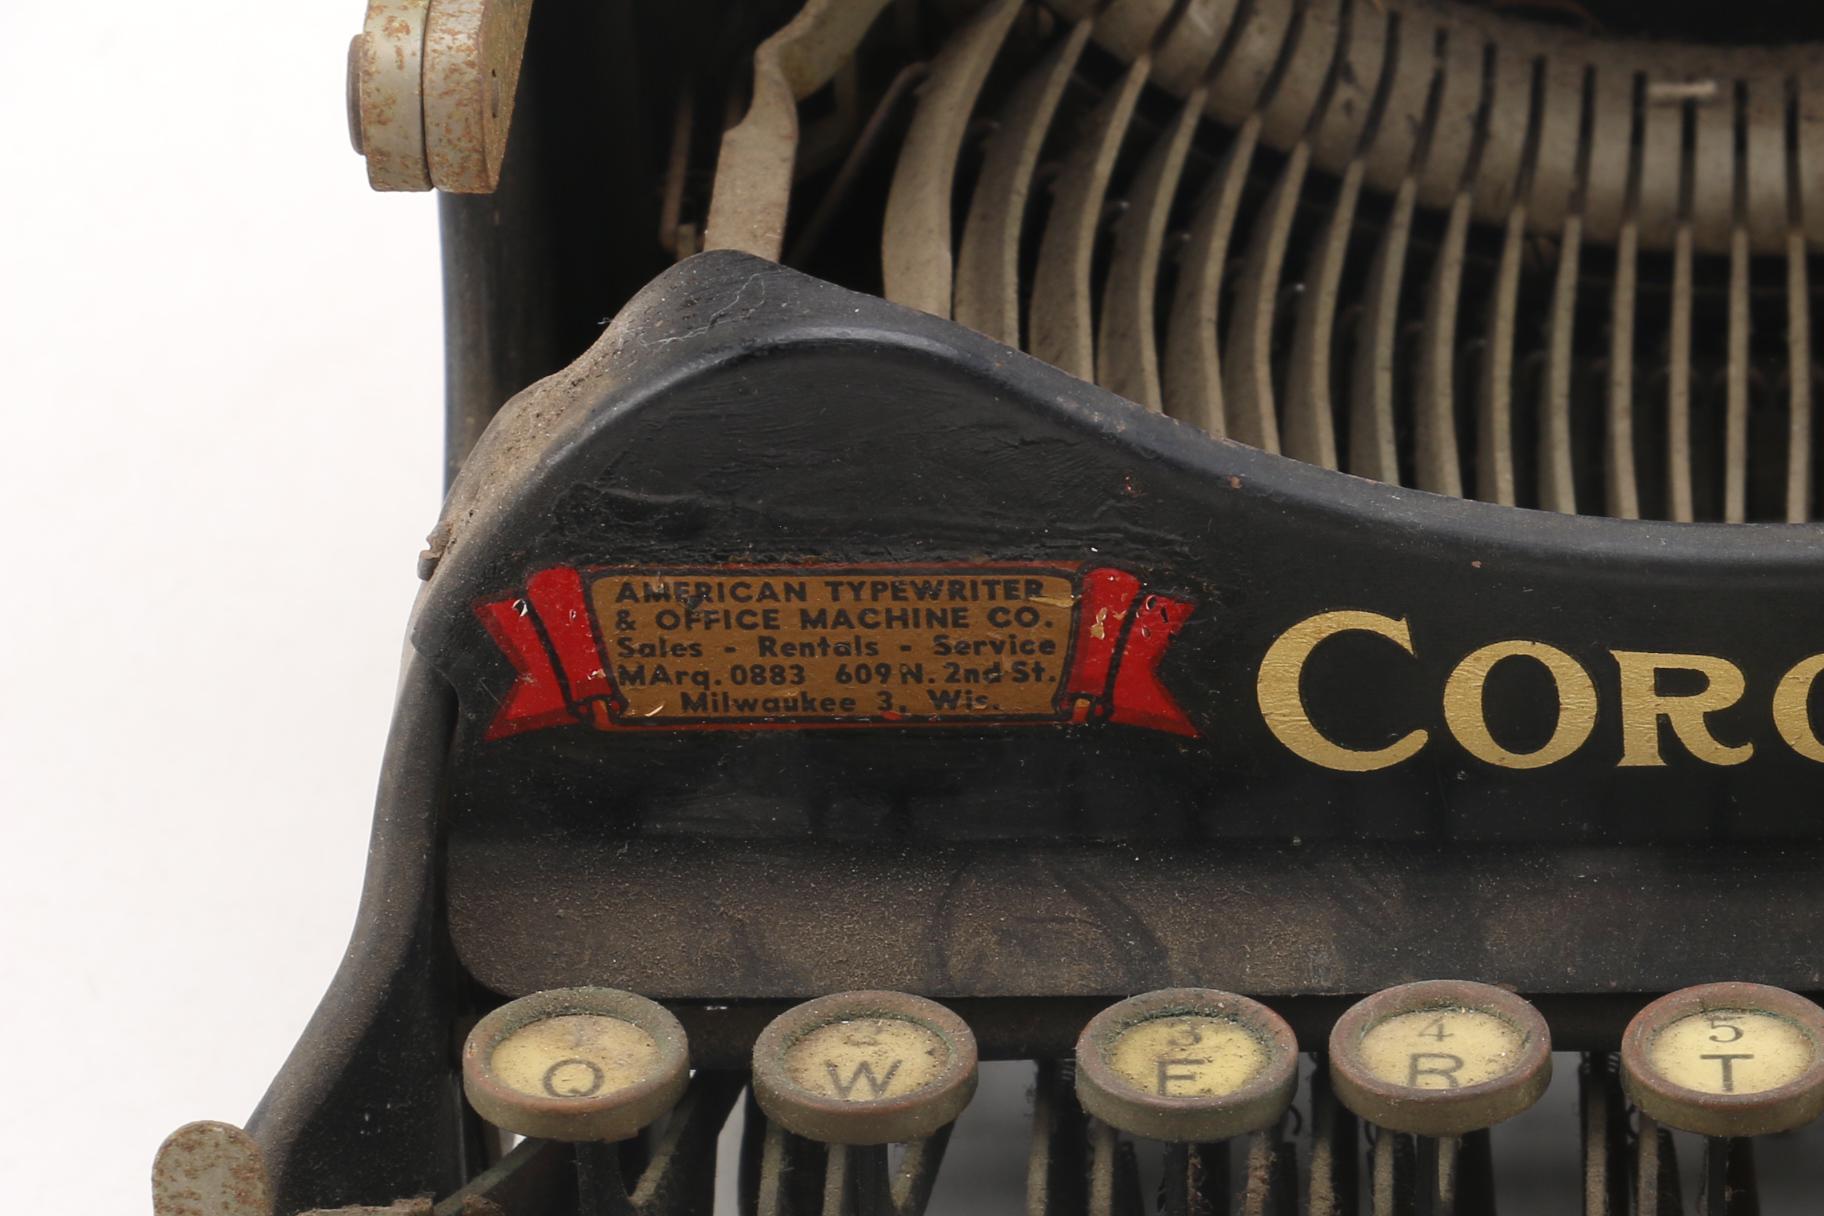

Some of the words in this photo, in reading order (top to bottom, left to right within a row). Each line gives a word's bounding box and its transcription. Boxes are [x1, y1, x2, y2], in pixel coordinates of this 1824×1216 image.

[615, 580, 808, 604] AMERICAN
[824, 578, 1044, 602] TYPEWRITER
[615, 608, 637, 631] &
[655, 608, 781, 631] OFFICE
[800, 606, 970, 631] MACHINE
[986, 605, 1054, 630] CO.
[616, 636, 704, 658] Sales
[757, 634, 880, 658] Rentals
[932, 632, 1057, 657] Service
[617, 663, 723, 690] MArq.
[730, 663, 806, 686] 0883
[835, 662, 892, 685] 609
[943, 660, 1003, 684] 2nd
[1010, 659, 1056, 683] St.
[680, 690, 857, 714] Milwaukee
[1417, 1018, 1453, 1043] 4
[1706, 1016, 1743, 1043] 5
[825, 1059, 902, 1098] W
[1700, 1053, 1754, 1093] T
